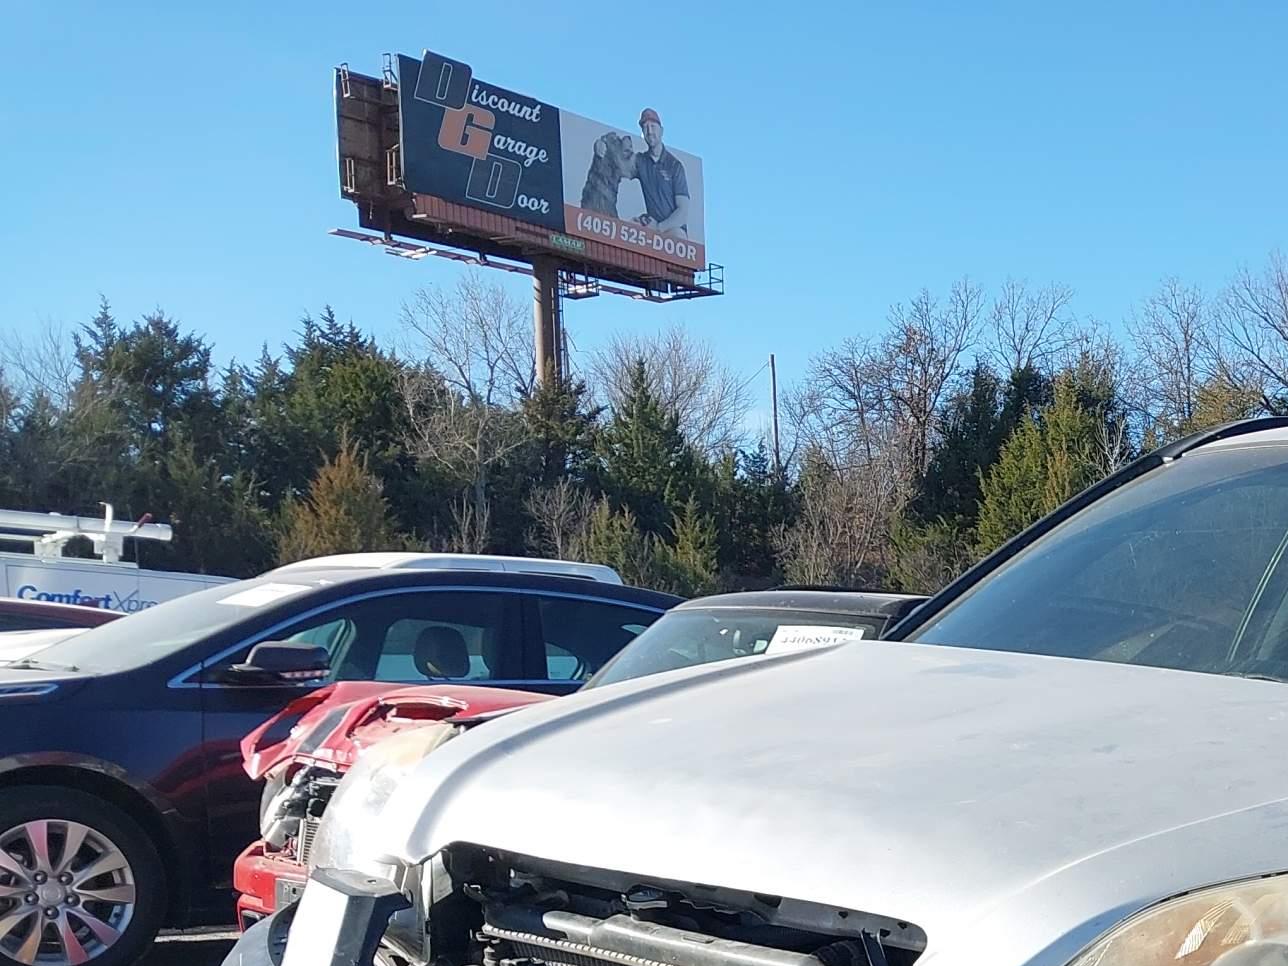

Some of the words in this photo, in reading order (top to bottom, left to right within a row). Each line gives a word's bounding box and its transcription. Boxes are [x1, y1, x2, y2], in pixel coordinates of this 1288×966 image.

[414, 49, 542, 123] Discount
[437, 103, 549, 168] Garage
[465, 152, 550, 214] Door
[577, 212, 617, 240] (405)
[620, 225, 697, 262] 525-DOOR
